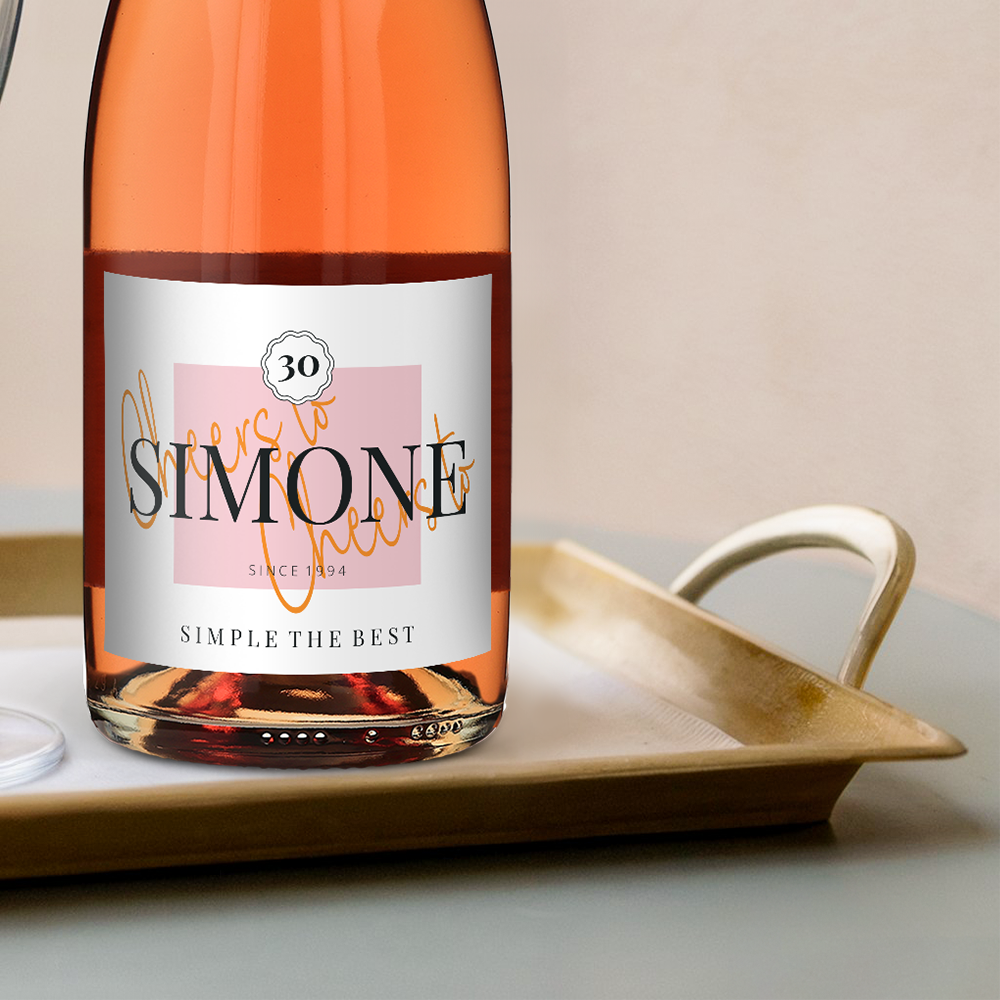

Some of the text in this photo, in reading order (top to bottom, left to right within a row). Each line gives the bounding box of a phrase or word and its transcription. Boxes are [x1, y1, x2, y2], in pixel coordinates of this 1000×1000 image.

[278, 355, 320, 382] 30
[130, 438, 467, 525] SIMONE
[248, 564, 347, 577] SINCE 1994
[180, 625, 415, 648] SIMPLE THE BEST
